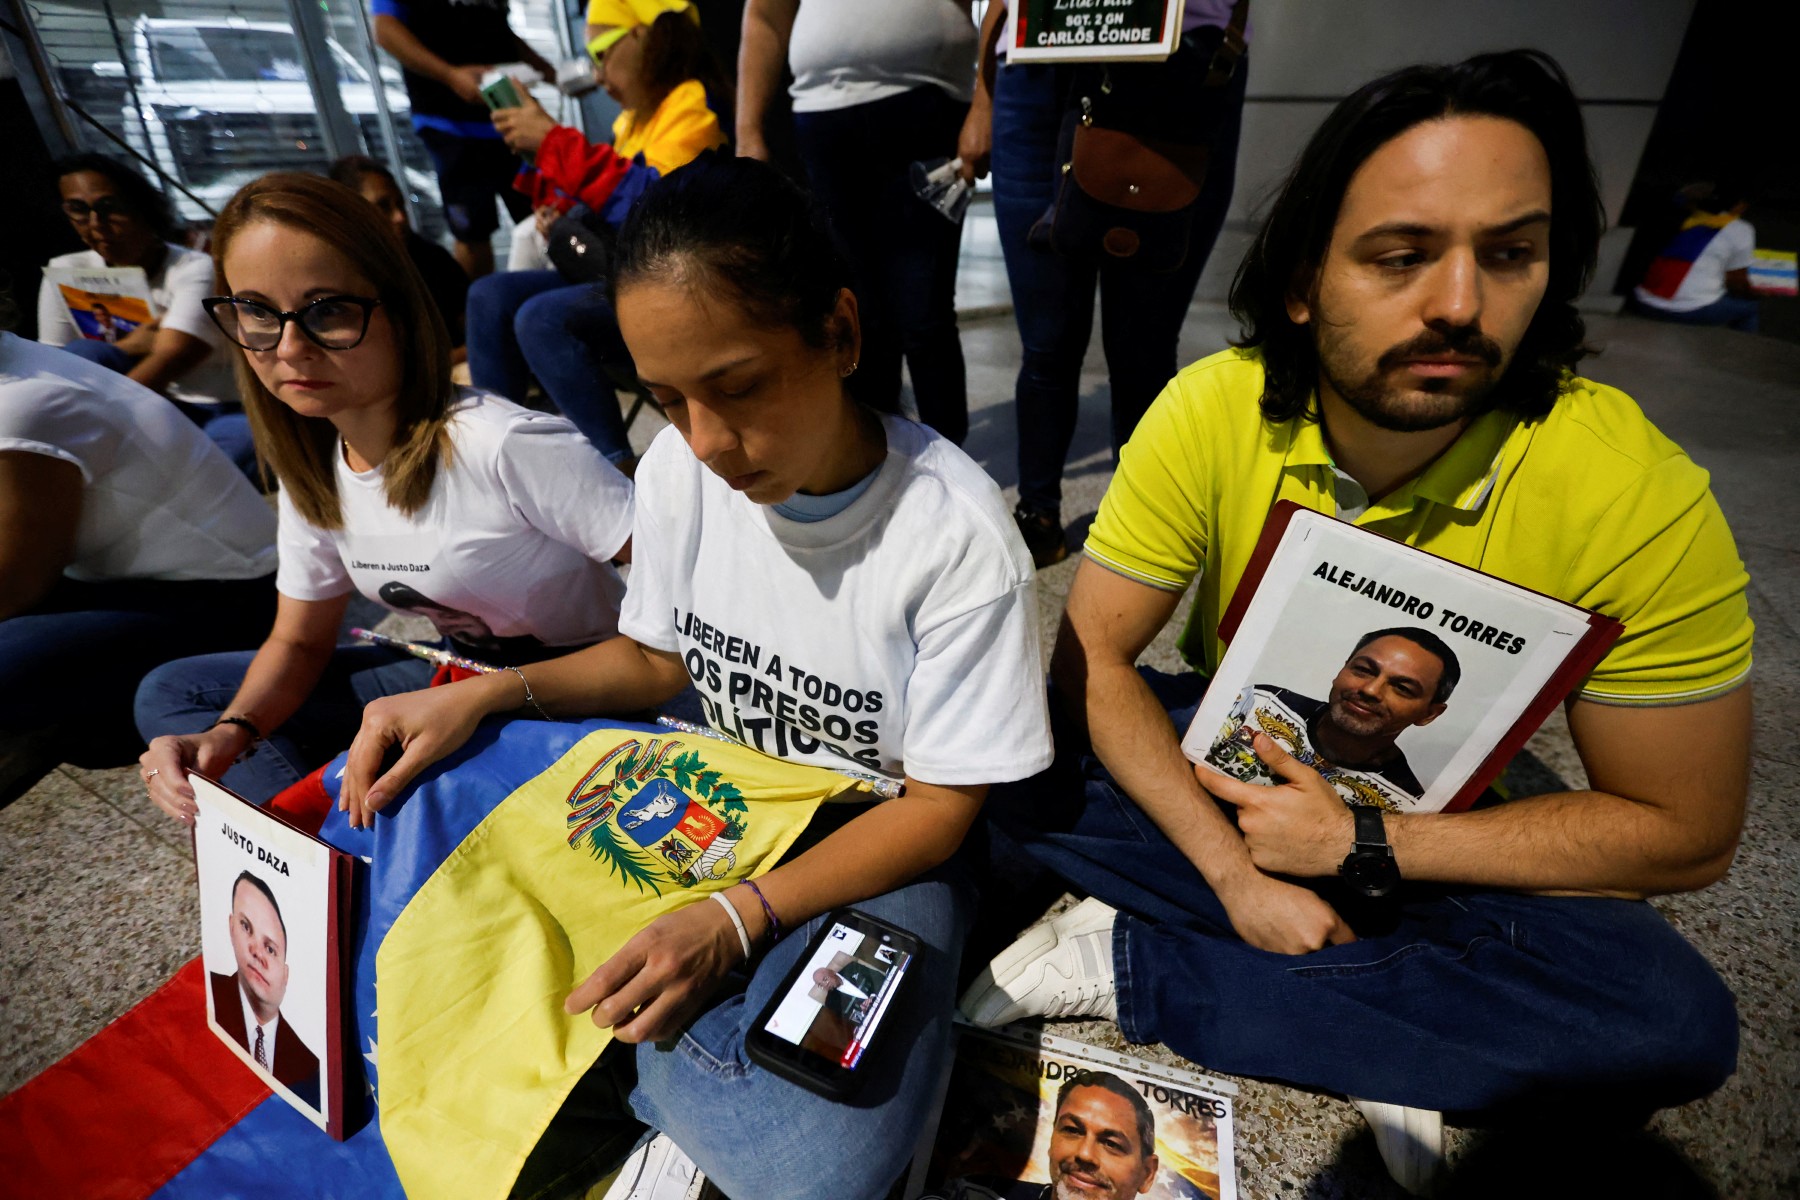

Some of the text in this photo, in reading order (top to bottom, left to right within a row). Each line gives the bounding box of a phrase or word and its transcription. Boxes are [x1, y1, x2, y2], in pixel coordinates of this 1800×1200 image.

[1065, 12, 1124, 27] SGT. 2 GN
[1098, 27, 1152, 43] CONDE
[352, 560, 380, 570] Liberen
[387, 562, 408, 571] Justo
[409, 563, 430, 572] Daza
[1313, 561, 1526, 655] ALEJANDRO TORRES
[674, 606, 883, 713] LIBEREN A TODOS
[685, 647, 879, 745] OS PRESOS
[221, 822, 290, 877] JUSTO DAZA
[1136, 1079, 1227, 1119] TORRES
